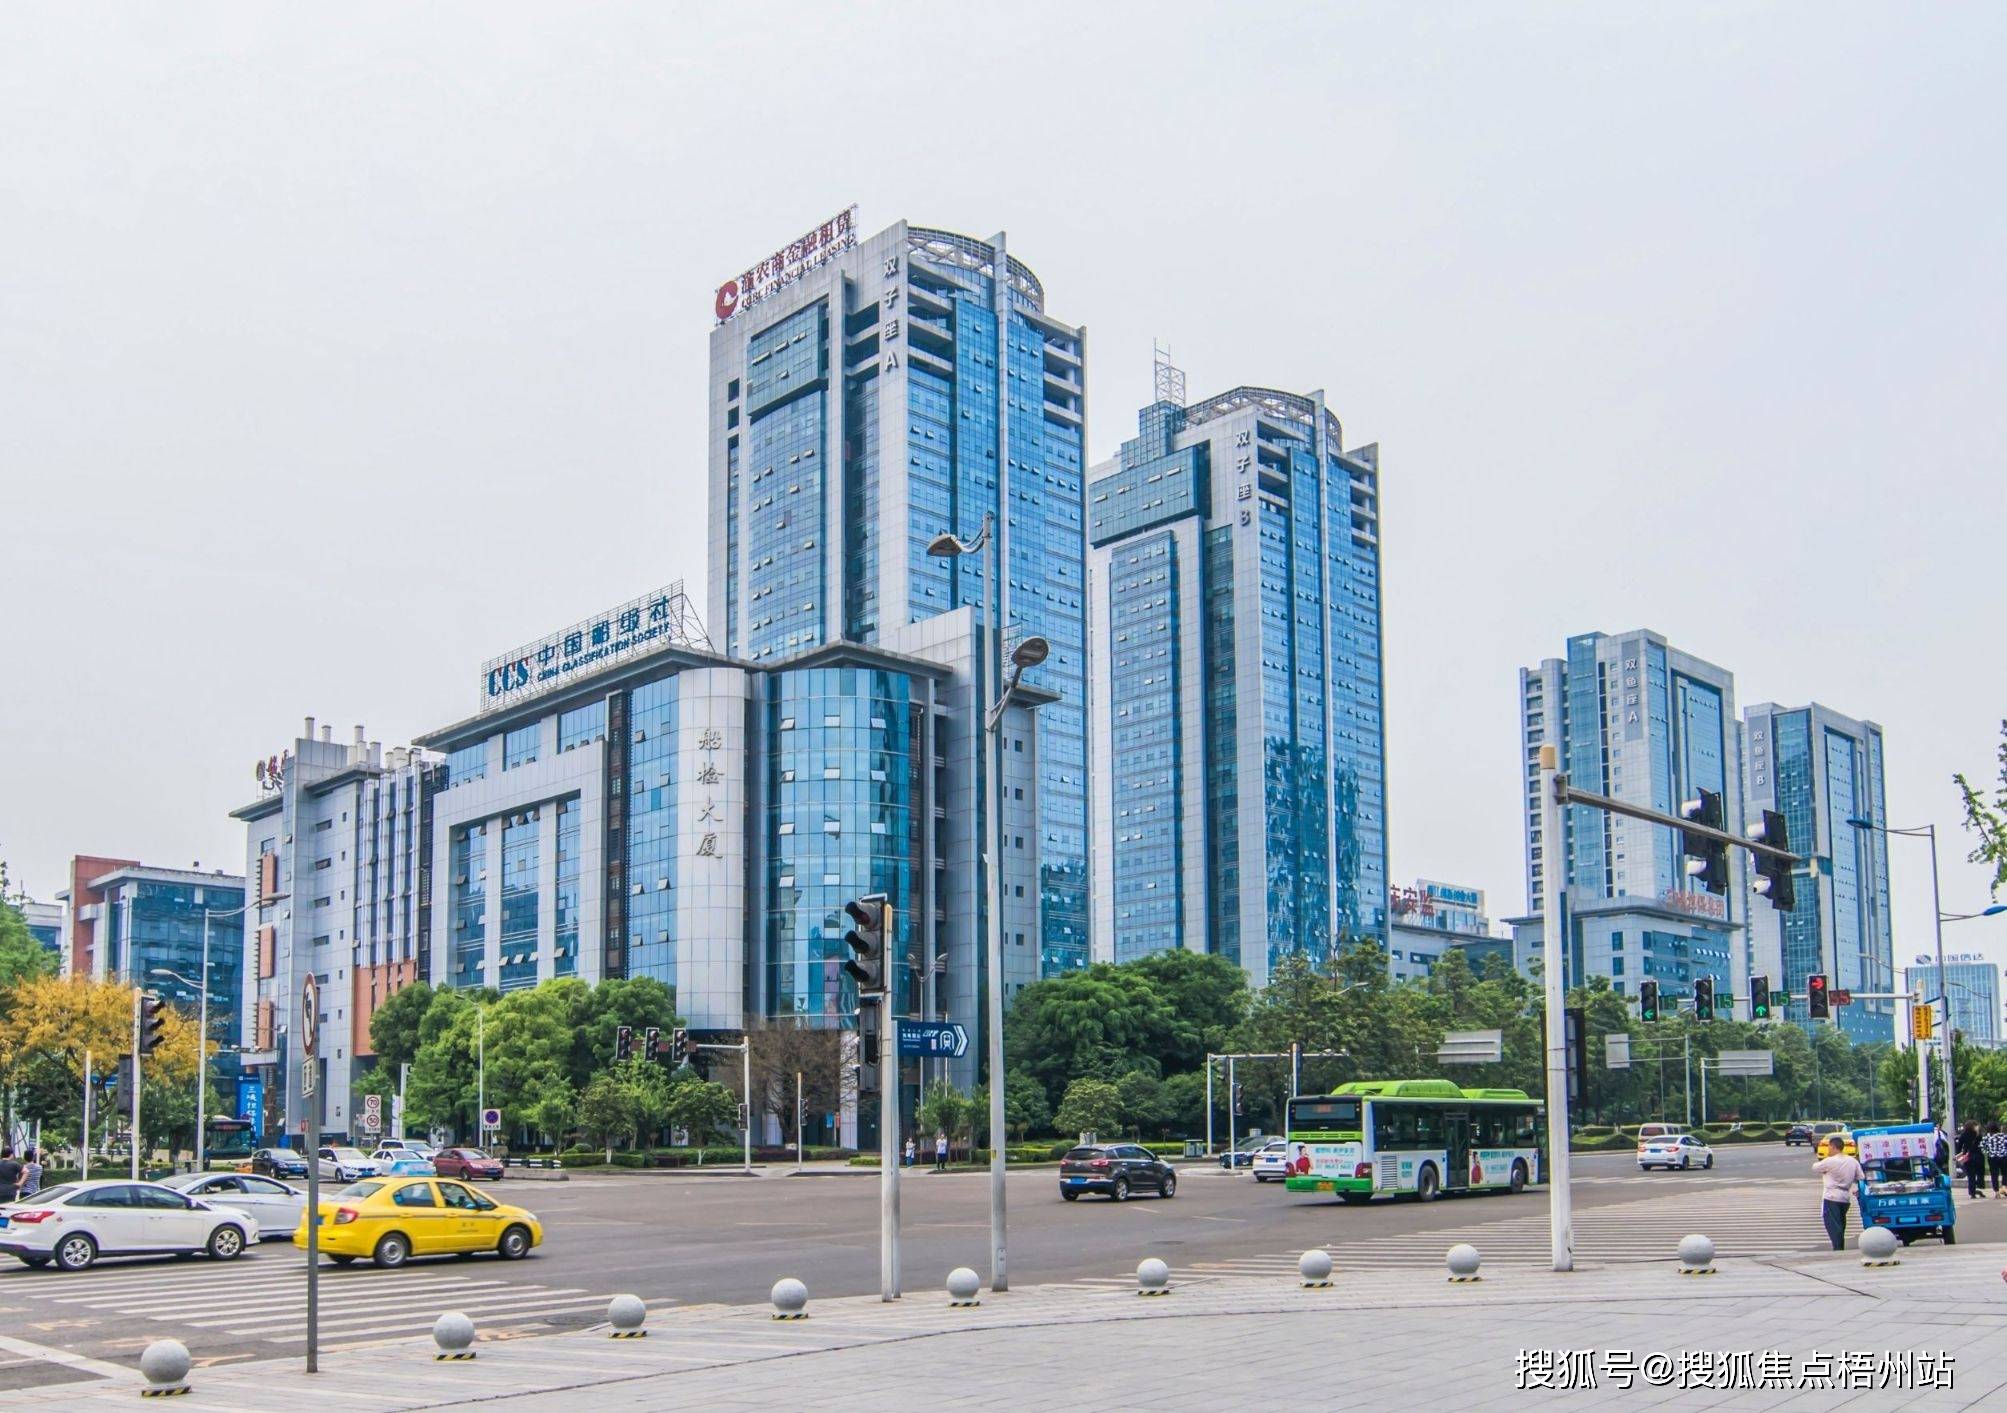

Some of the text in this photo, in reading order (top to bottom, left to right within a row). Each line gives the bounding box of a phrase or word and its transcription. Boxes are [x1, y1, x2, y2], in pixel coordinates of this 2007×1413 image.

[765, 259, 812, 295] FINANCIAL
[883, 256, 899, 372] 双子座A
[1236, 430, 1251, 526] 双子座B
[538, 596, 669, 666] 中国船级社
[562, 637, 630, 672] CLASSIFICATION
[488, 657, 530, 696] CCS
[1625, 658, 1639, 723] 双鱼座A
[696, 730, 724, 859] 船检大厦
